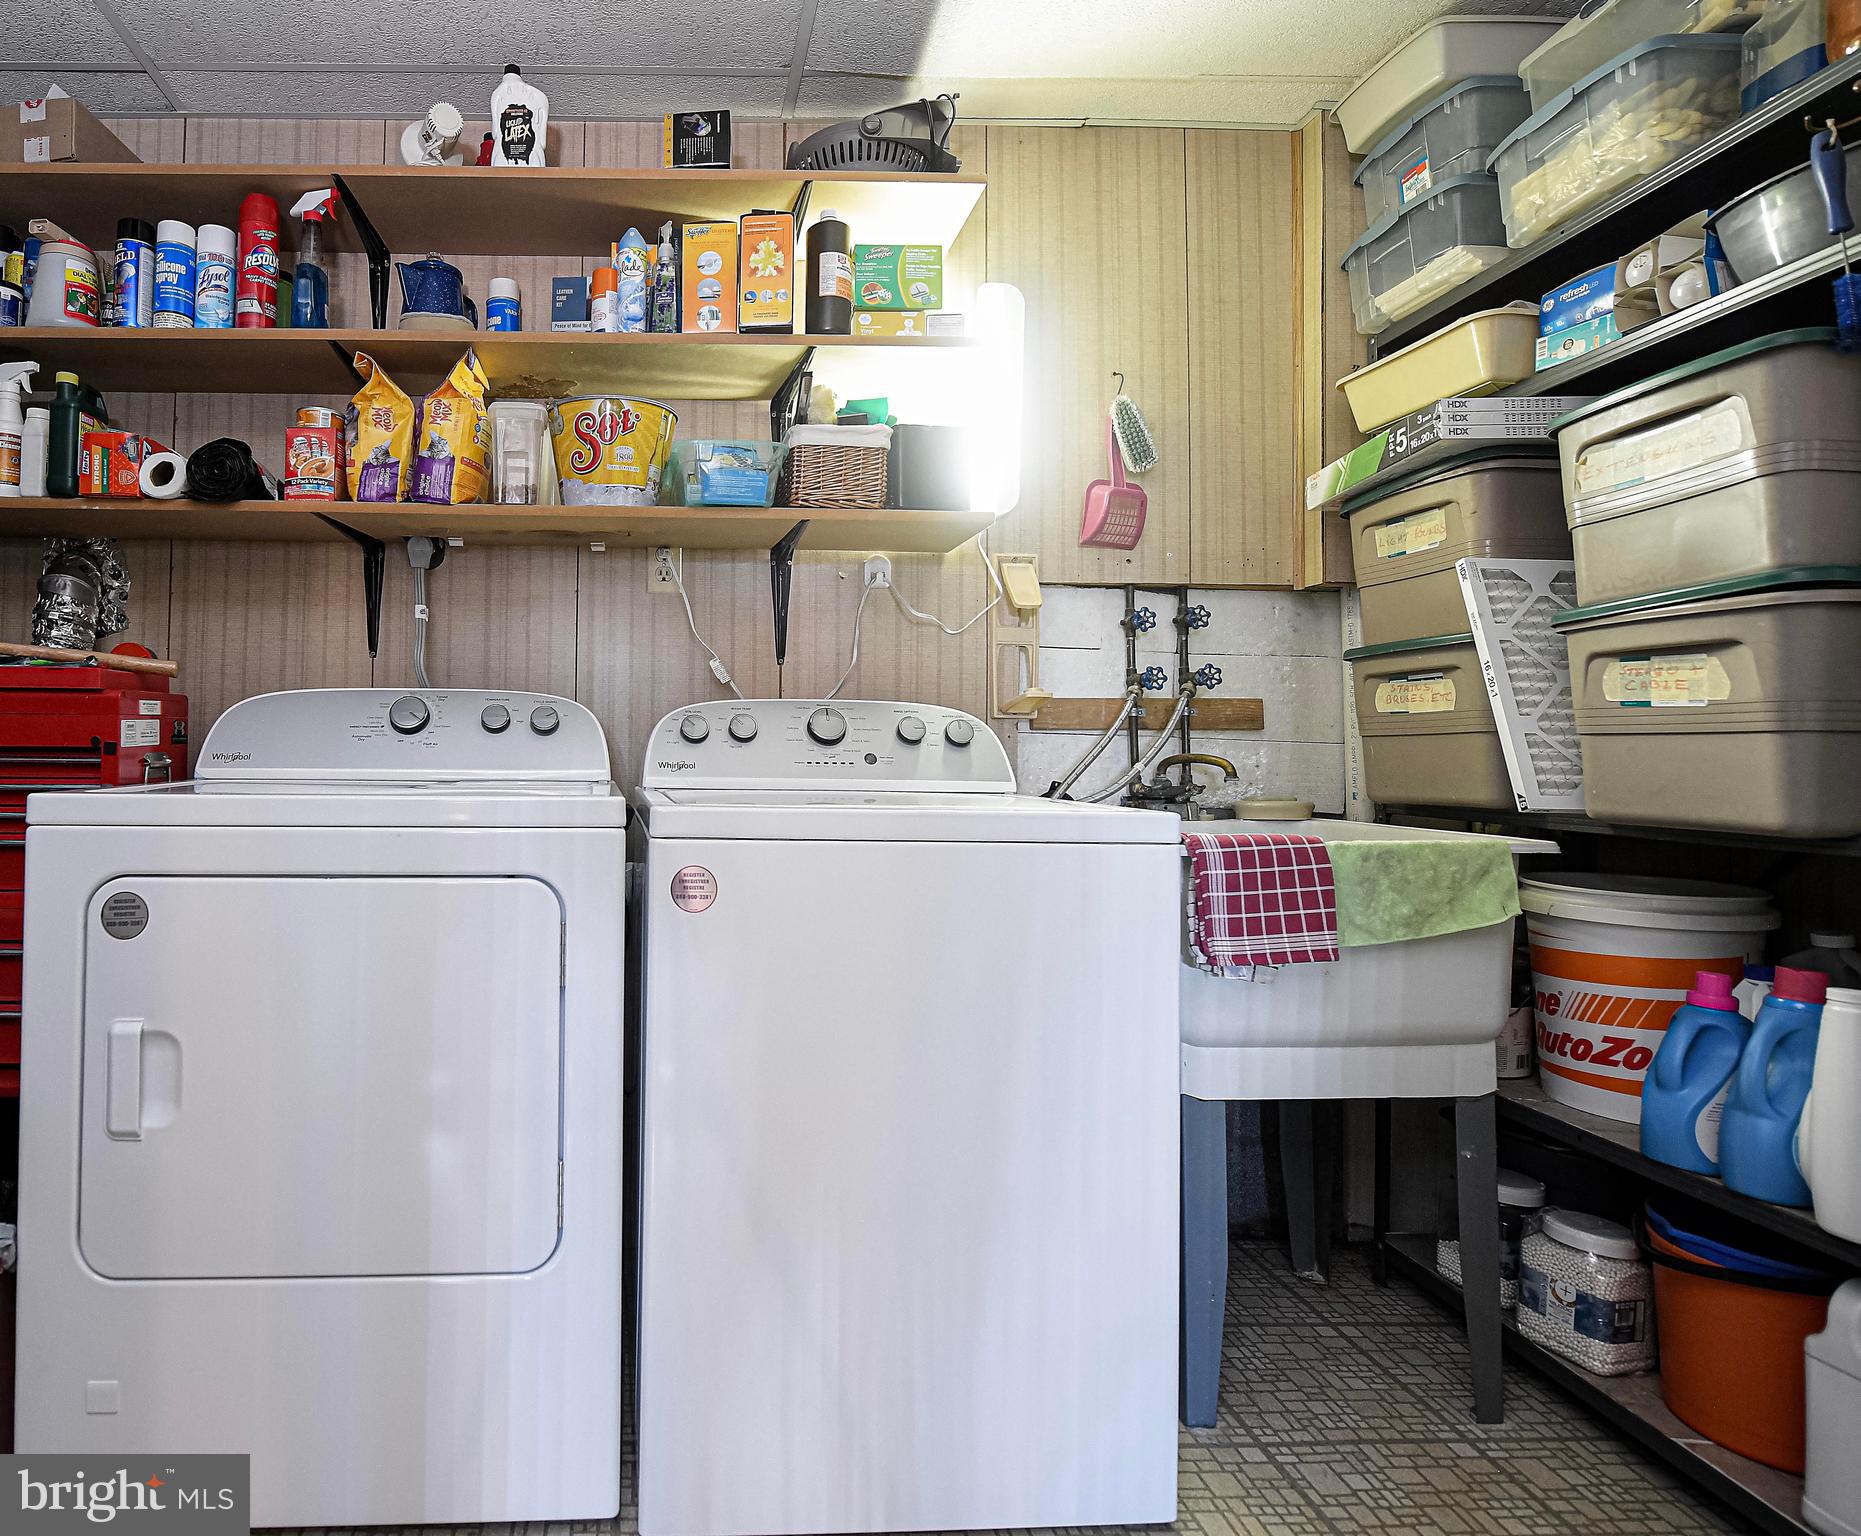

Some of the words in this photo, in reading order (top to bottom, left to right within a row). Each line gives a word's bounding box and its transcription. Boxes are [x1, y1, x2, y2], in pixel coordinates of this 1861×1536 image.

[505, 124, 531, 142] LATEX
[156, 261, 186, 275] silicone
[156, 272, 178, 285] spray
[199, 268, 230, 288] Lysol
[1560, 282, 1589, 301] refresh
[428, 398, 443, 426] Meow
[1447, 400, 1468, 408] HDX
[1417, 415, 1422, 424] 3
[1448, 414, 1468, 422] HDX
[1448, 427, 1469, 436] HDX
[1388, 433, 1396, 458] FPR
[1396, 427, 1407, 453] 5
[1458, 562, 1469, 582] HDX
[212, 752, 252, 764] Whirlpool
[657, 761, 696, 773] Whirlpool
[1538, 1021, 1654, 1071] AutoZo
